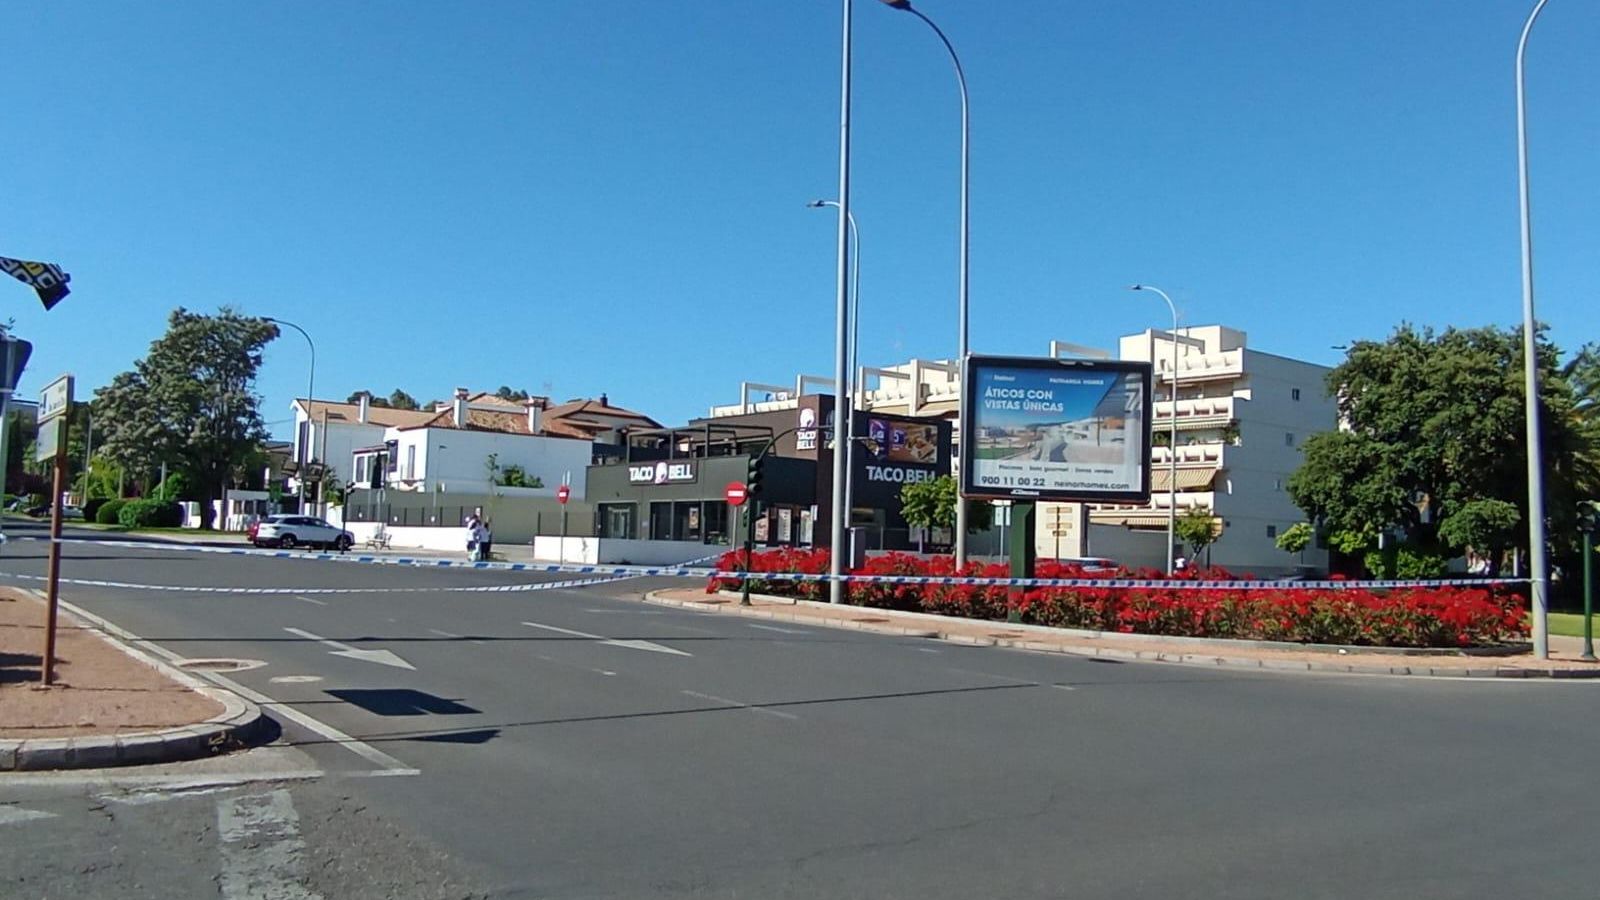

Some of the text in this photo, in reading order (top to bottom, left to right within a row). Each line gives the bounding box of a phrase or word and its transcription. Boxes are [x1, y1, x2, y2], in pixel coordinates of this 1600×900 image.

[984, 386, 1053, 400] ÁTICOS CON
[984, 399, 1064, 412] VISTAS ÚNICAS
[797, 431, 816, 440] TACO
[796, 440, 816, 449] BELL
[629, 464, 693, 481] TACO BELL
[865, 466, 904, 482] TACO
[981, 476, 1000, 485] 900
[1004, 477, 1014, 485] 11
[1018, 477, 1030, 486] 00
[1033, 478, 1046, 486] 22
